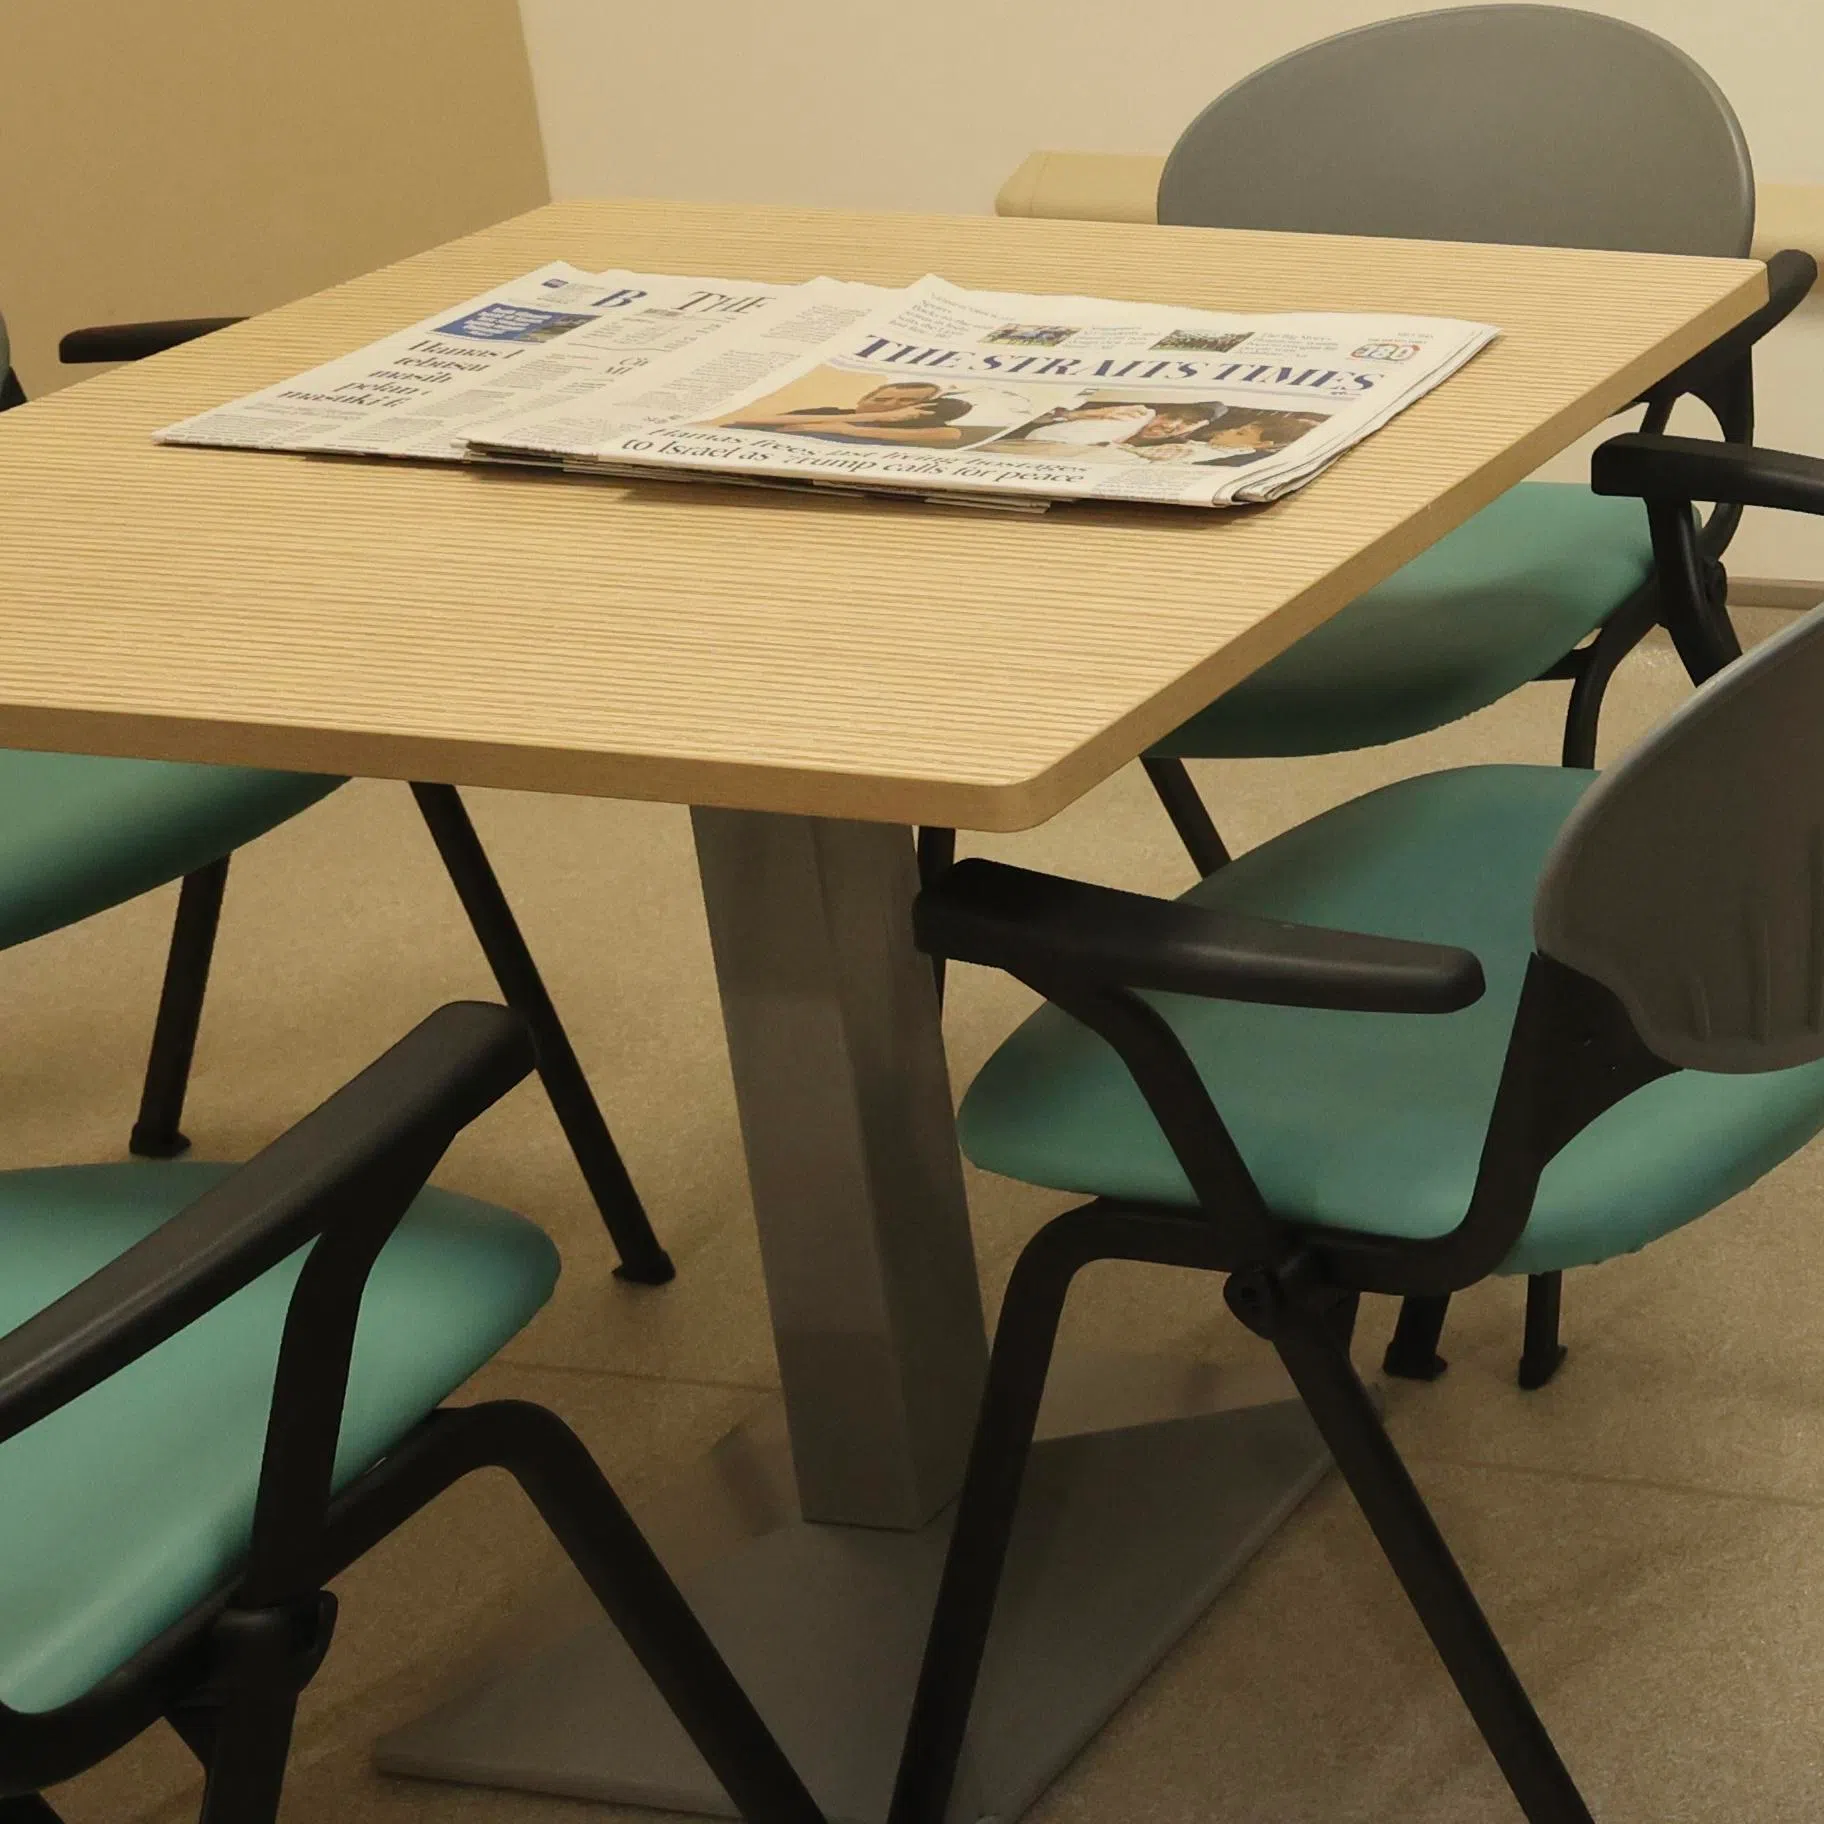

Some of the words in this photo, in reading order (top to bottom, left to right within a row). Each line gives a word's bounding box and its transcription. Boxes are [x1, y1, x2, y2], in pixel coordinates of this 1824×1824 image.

[408, 340, 499, 358] Hamas
[855, 334, 976, 369] THE
[968, 354, 1209, 379] STRAITS
[1212, 362, 1385, 391] TIMES
[621, 438, 653, 451] to
[658, 440, 740, 460] Israel
[740, 449, 774, 462] as
[883, 460, 944, 475] calls
[950, 463, 990, 478] for
[994, 468, 1086, 483] peace
